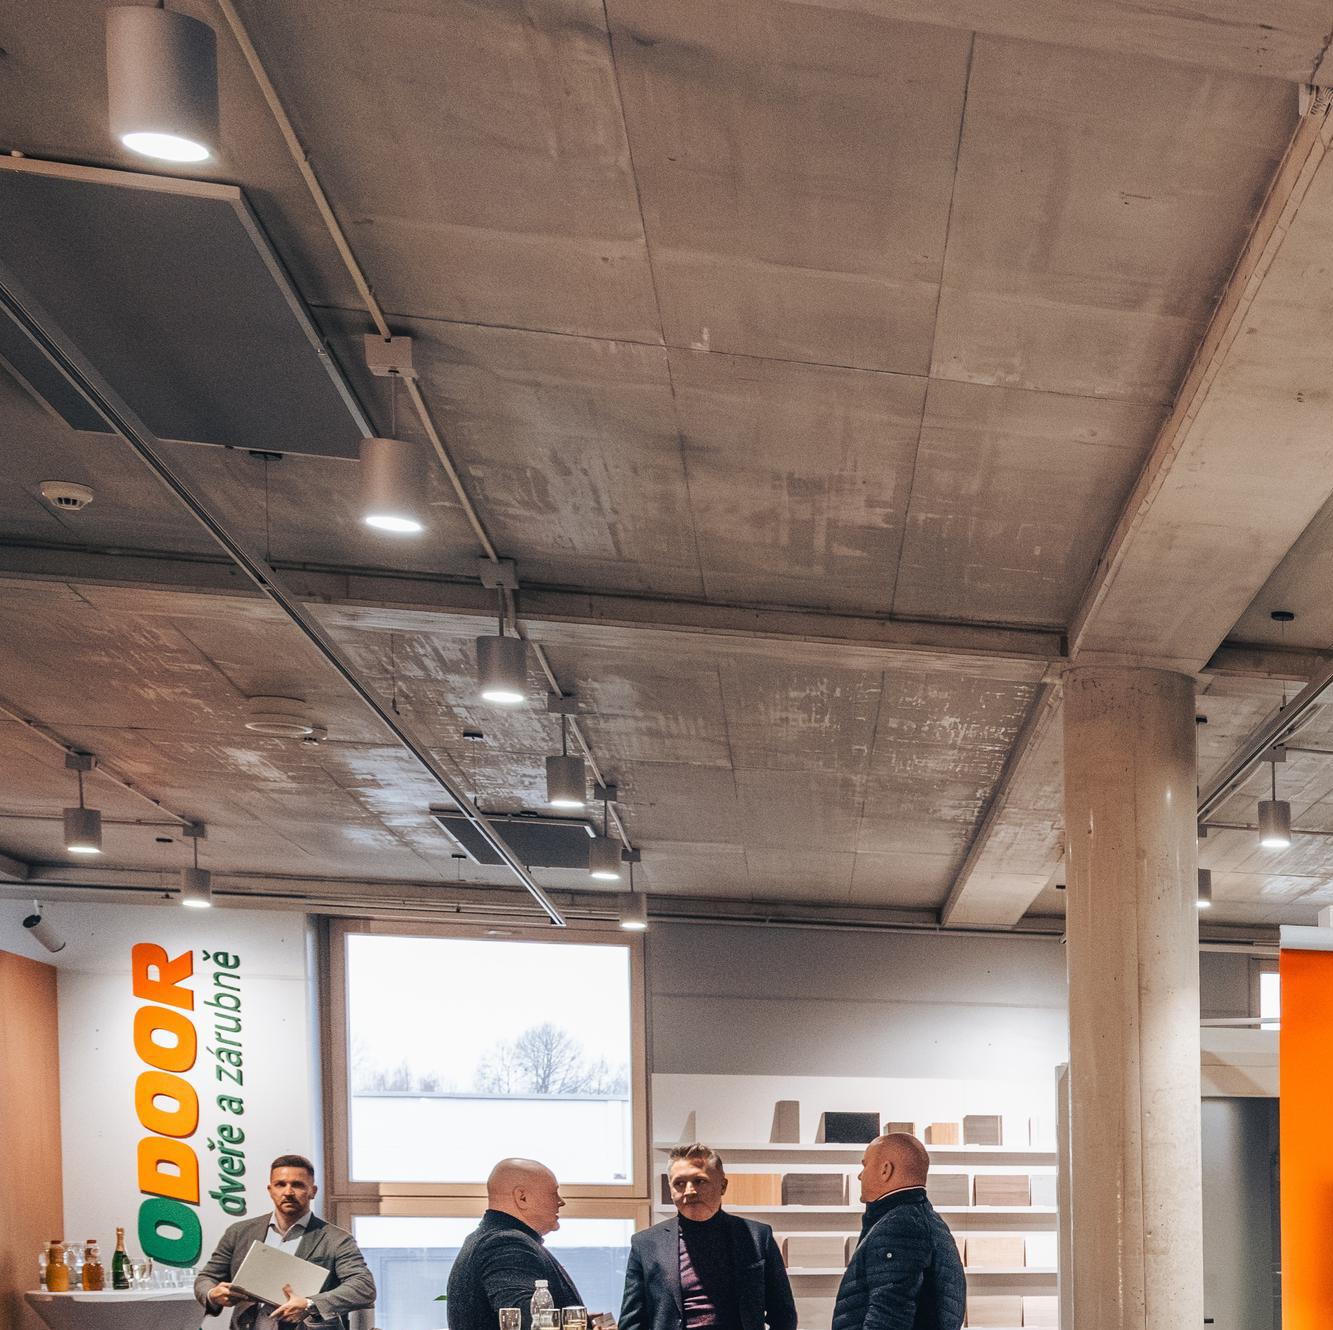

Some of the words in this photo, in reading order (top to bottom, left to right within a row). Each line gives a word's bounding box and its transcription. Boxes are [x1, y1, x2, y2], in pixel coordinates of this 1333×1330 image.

[202, 949, 245, 1086] zárubně
[216, 1094, 245, 1115] a
[207, 1124, 246, 1216] dveře
